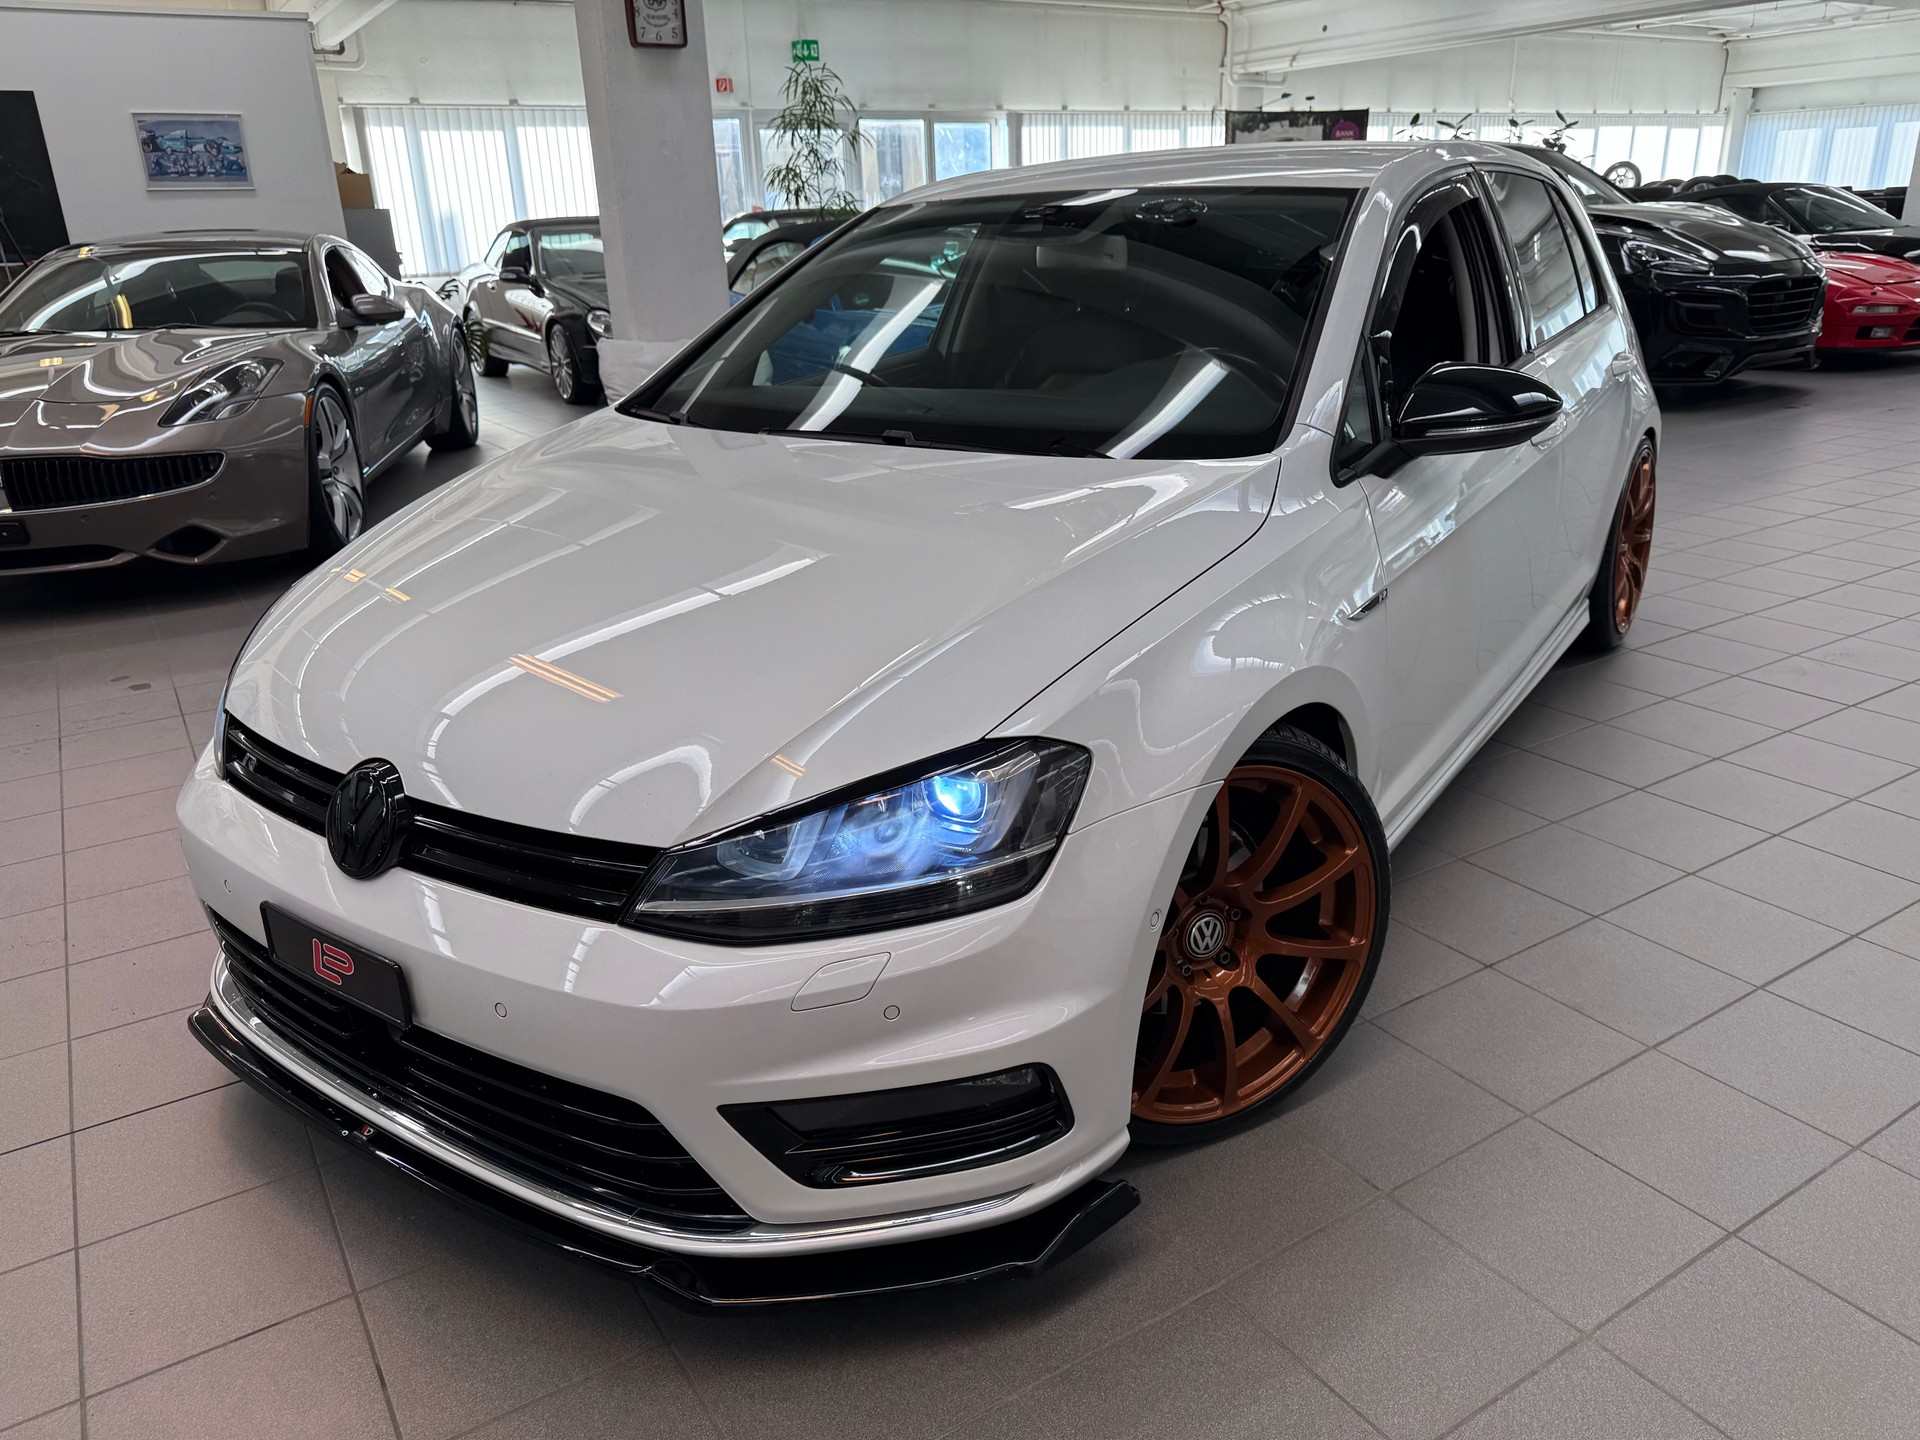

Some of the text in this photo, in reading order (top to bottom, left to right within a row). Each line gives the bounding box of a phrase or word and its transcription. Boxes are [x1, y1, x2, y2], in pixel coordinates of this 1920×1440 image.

[640, 26, 646, 39] 7
[655, 30, 662, 42] 6
[671, 27, 678, 39] 5
[1190, 916, 1223, 954] VW
